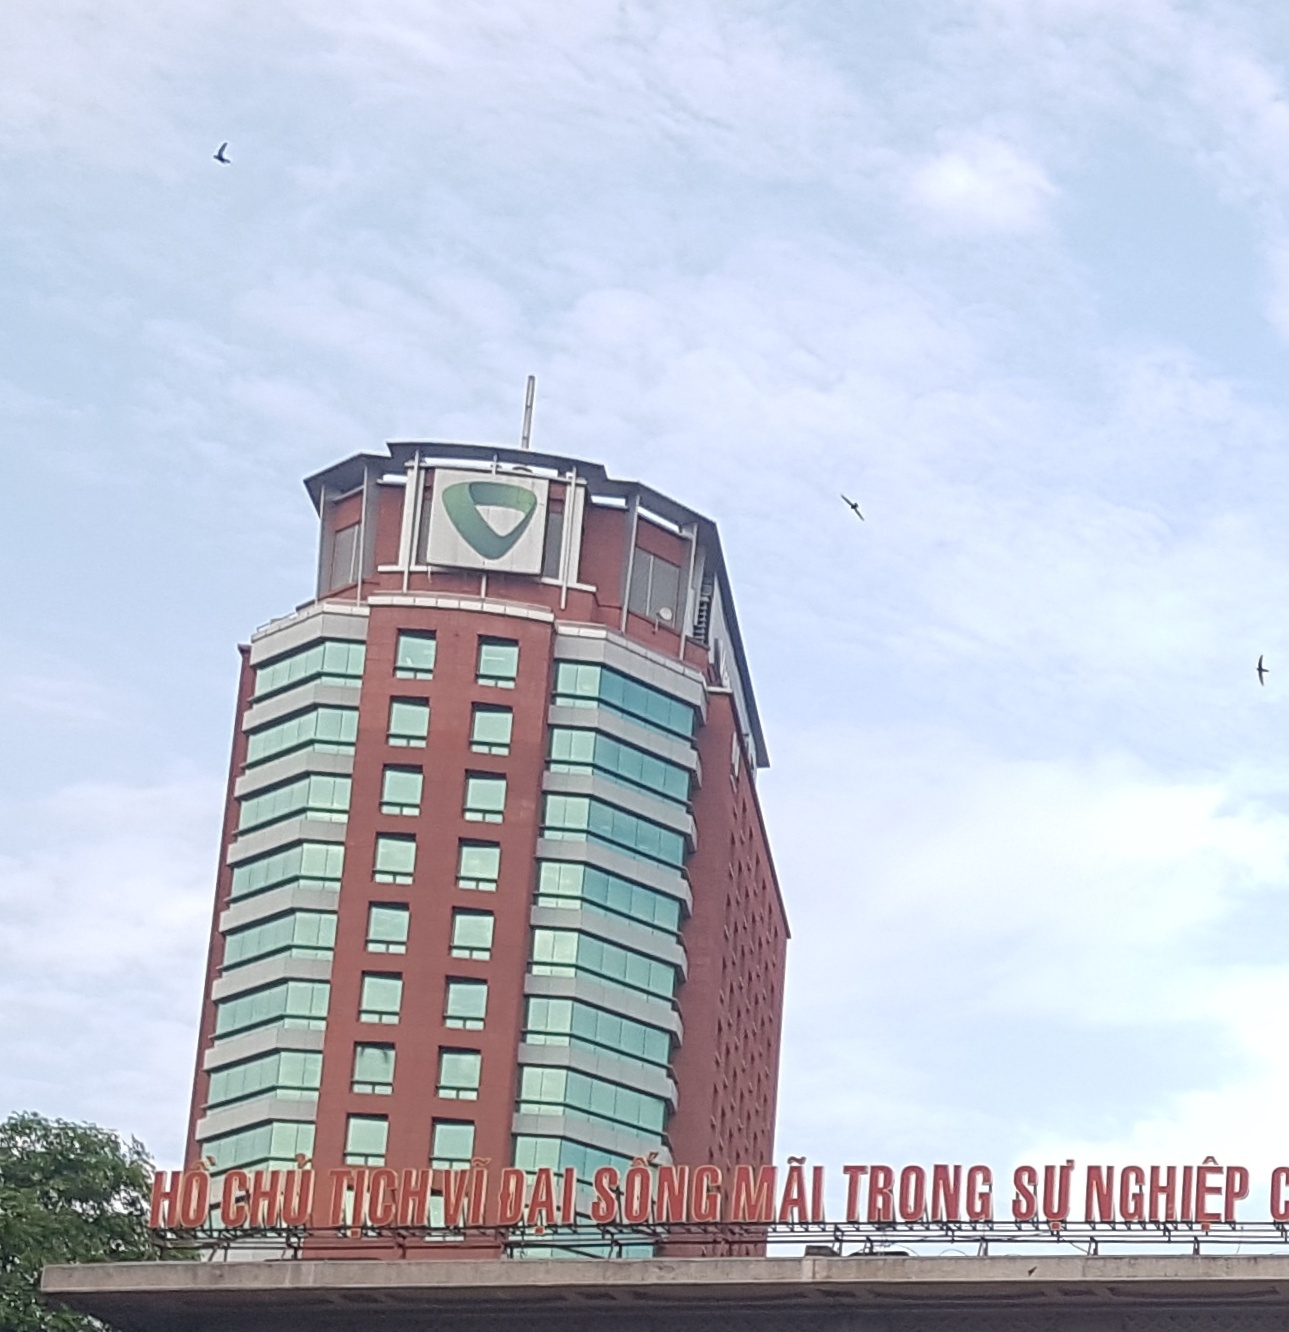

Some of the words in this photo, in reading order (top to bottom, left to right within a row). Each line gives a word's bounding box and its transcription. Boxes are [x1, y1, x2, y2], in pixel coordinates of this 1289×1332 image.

[149, 1155, 212, 1228] HỒ
[219, 1152, 314, 1228] CHỦ
[329, 1168, 431, 1238] TỊCH
[440, 1156, 493, 1225] VĨ
[500, 1166, 577, 1235] ĐẠI
[590, 1151, 722, 1224] SỐNG
[731, 1156, 826, 1223] MÃI
[842, 1164, 993, 1222] TRONG
[1013, 1159, 1075, 1231] SỰ
[1085, 1156, 1250, 1232] NGHIỆP
